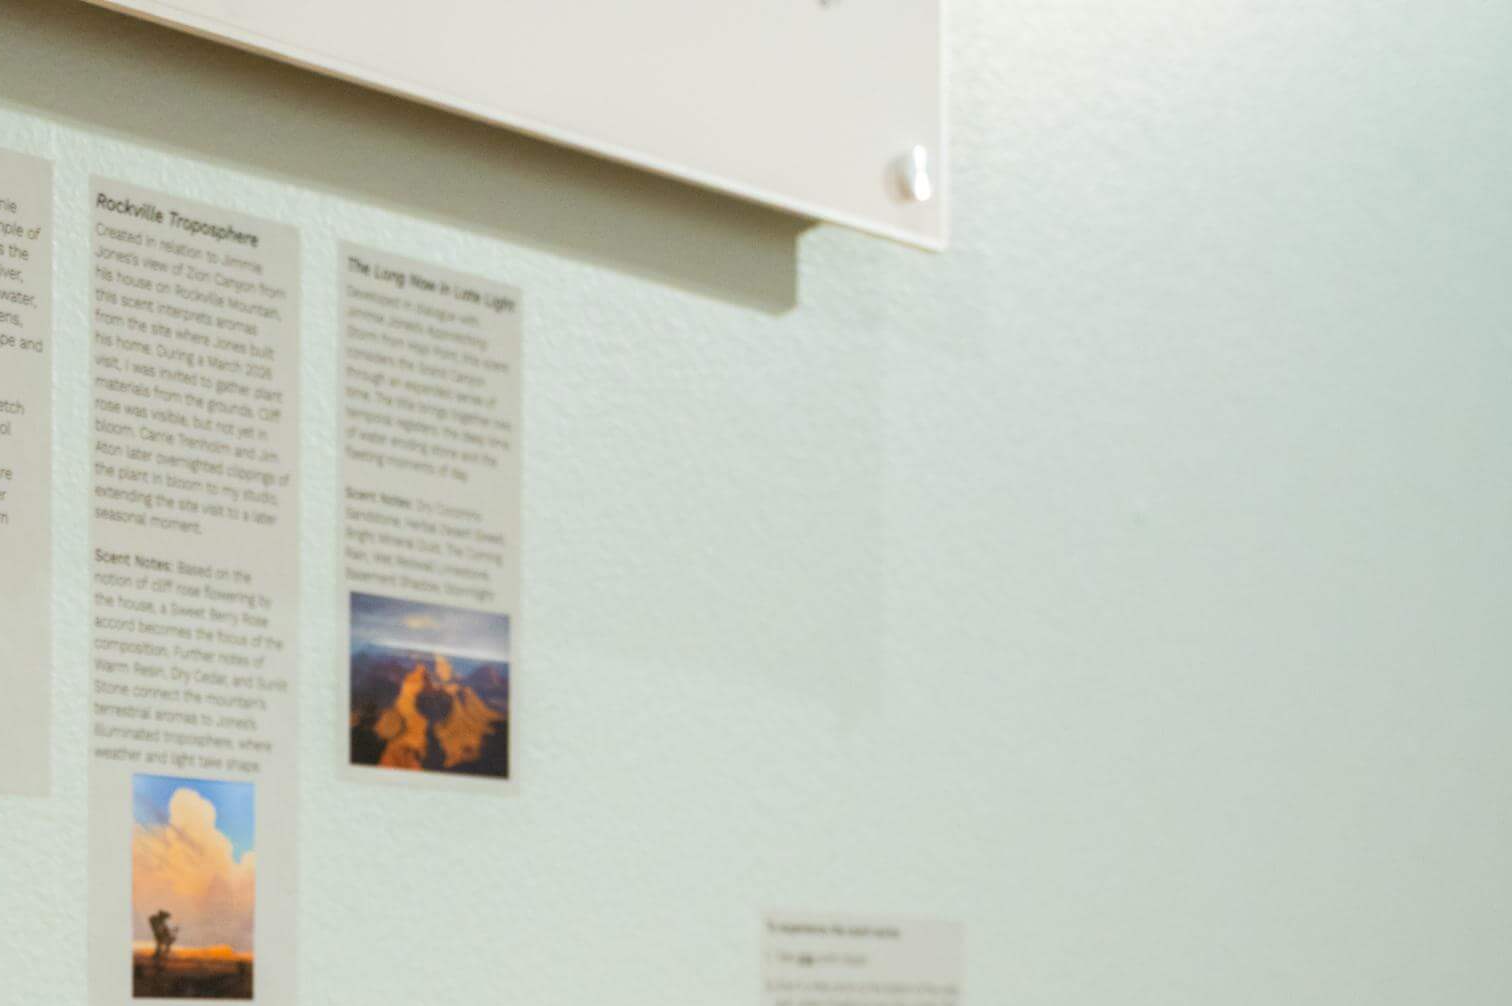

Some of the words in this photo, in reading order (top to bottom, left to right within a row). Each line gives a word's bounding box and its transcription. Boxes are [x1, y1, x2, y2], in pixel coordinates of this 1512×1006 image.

[95, 192, 165, 224] Rockville
[168, 210, 260, 248] Troposphere
[26, 227, 42, 240] of
[7, 244, 30, 261] the
